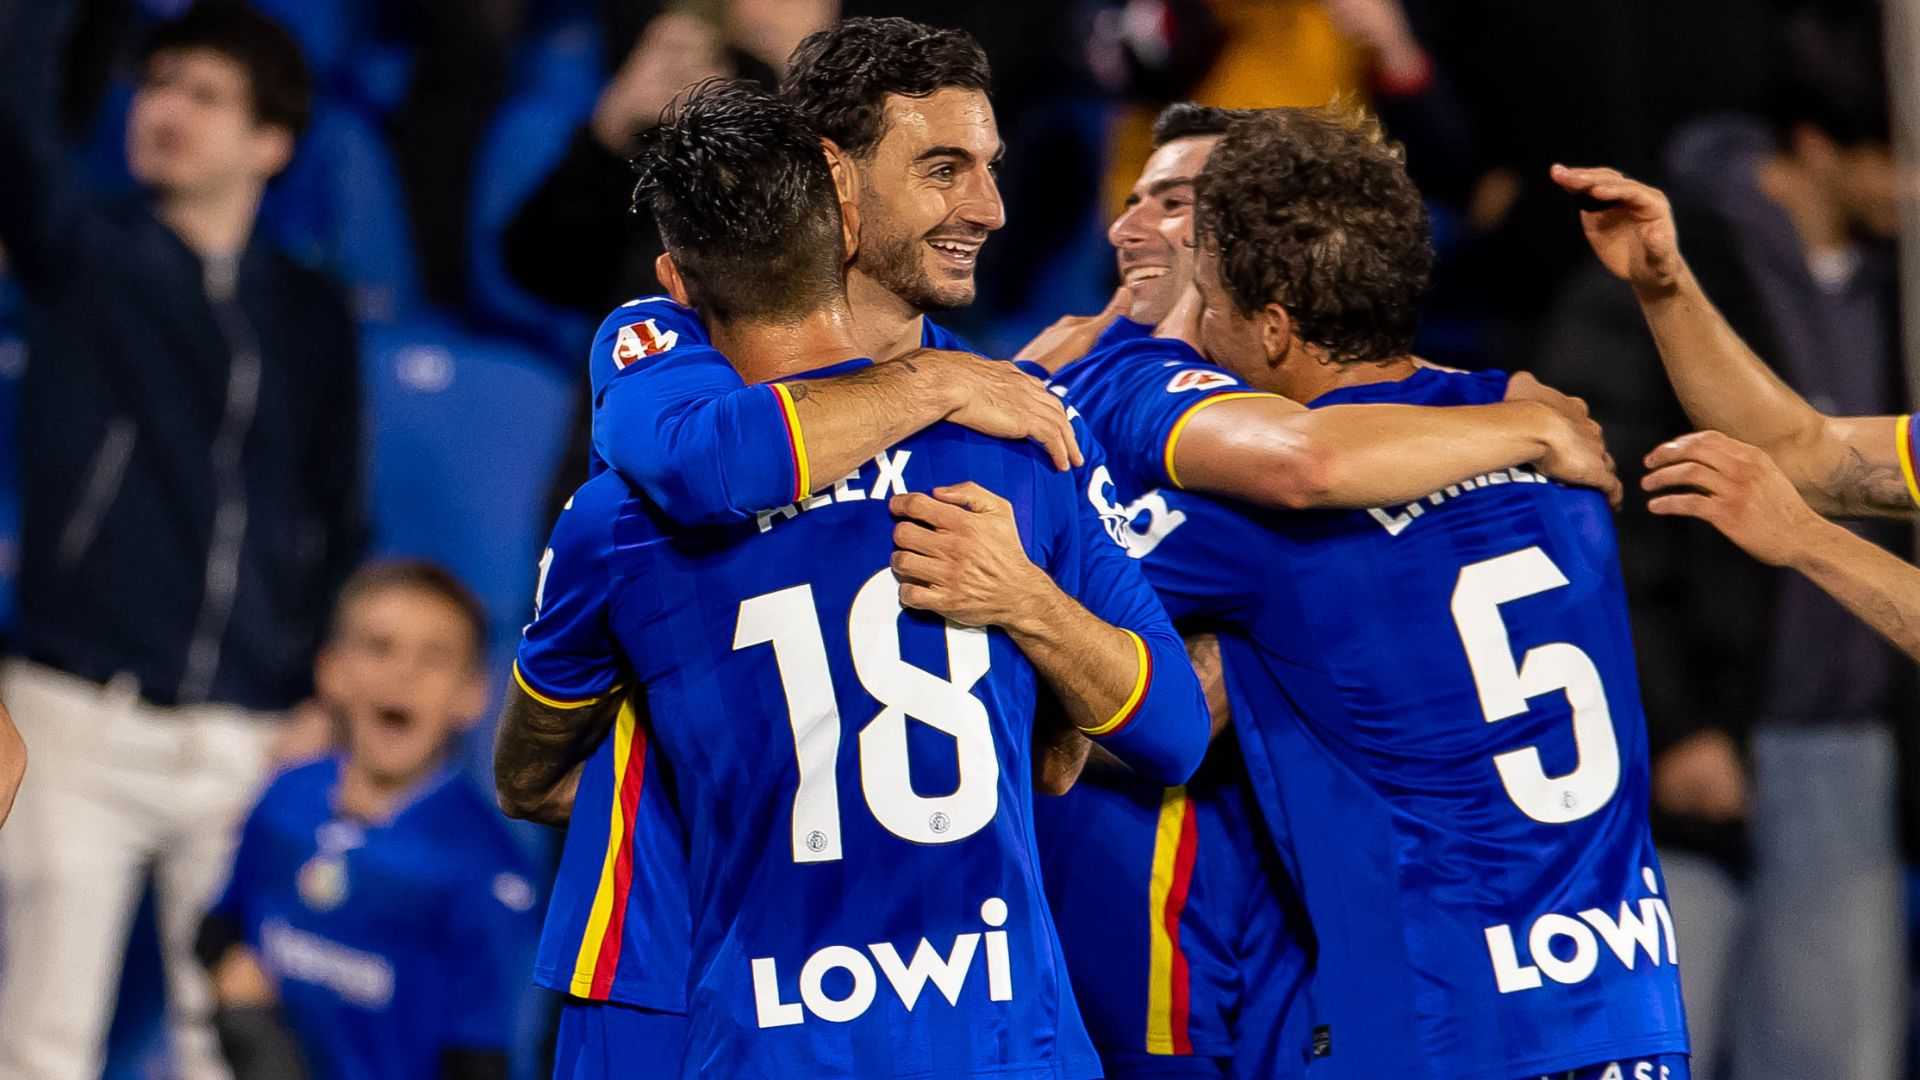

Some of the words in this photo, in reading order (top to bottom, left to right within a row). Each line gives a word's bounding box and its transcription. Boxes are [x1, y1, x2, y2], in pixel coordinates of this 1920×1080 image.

[757, 450, 912, 533] EX
[733, 565, 999, 863] 18
[1451, 545, 1620, 824] 5
